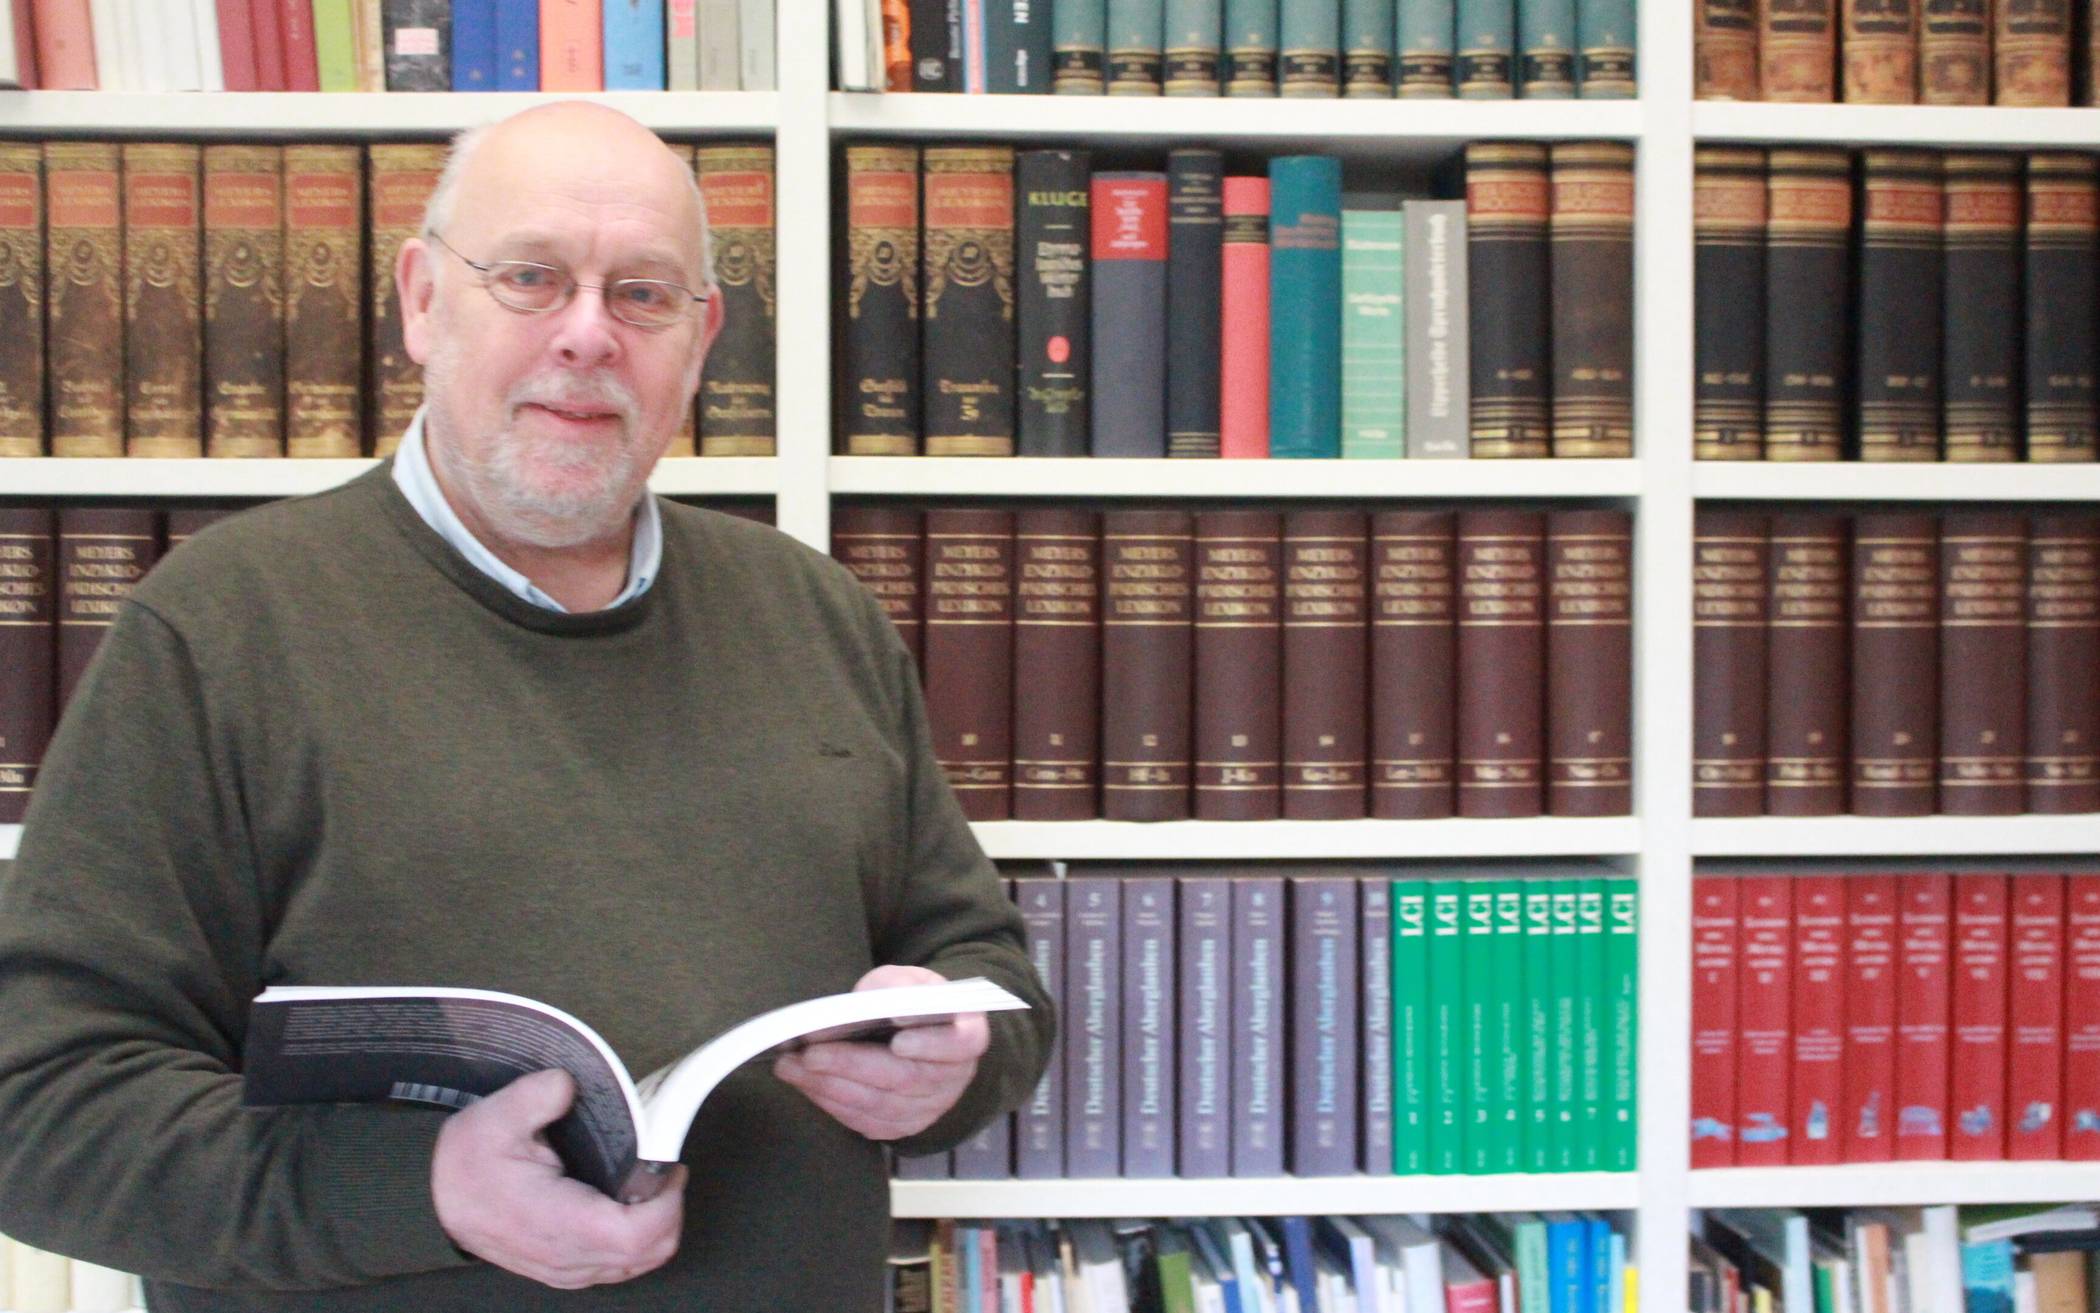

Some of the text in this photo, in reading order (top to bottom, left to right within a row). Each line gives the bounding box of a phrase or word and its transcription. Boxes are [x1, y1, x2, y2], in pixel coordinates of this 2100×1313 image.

[1400, 895, 1424, 937] LCI
[1435, 894, 1458, 937] LCI
[1468, 894, 1492, 936] LCI
[1497, 893, 1521, 935] LCI
[1526, 893, 1550, 936] LCI
[1553, 893, 1577, 936] LCI
[1579, 892, 1602, 935] LCI
[1611, 893, 1636, 935] LCI
[1084, 939, 1105, 1115] Deutscher Aberglauben
[1139, 939, 1161, 1115] Deutscher Aberglauben
[1195, 939, 1217, 1115] Deutscher Aberglauben
[1248, 939, 1270, 1115] Deutscher Aberglauben
[1315, 937, 1338, 1113] Deutscher Aberglauben
[1369, 937, 1389, 1112] Deutscher Aberglauben
